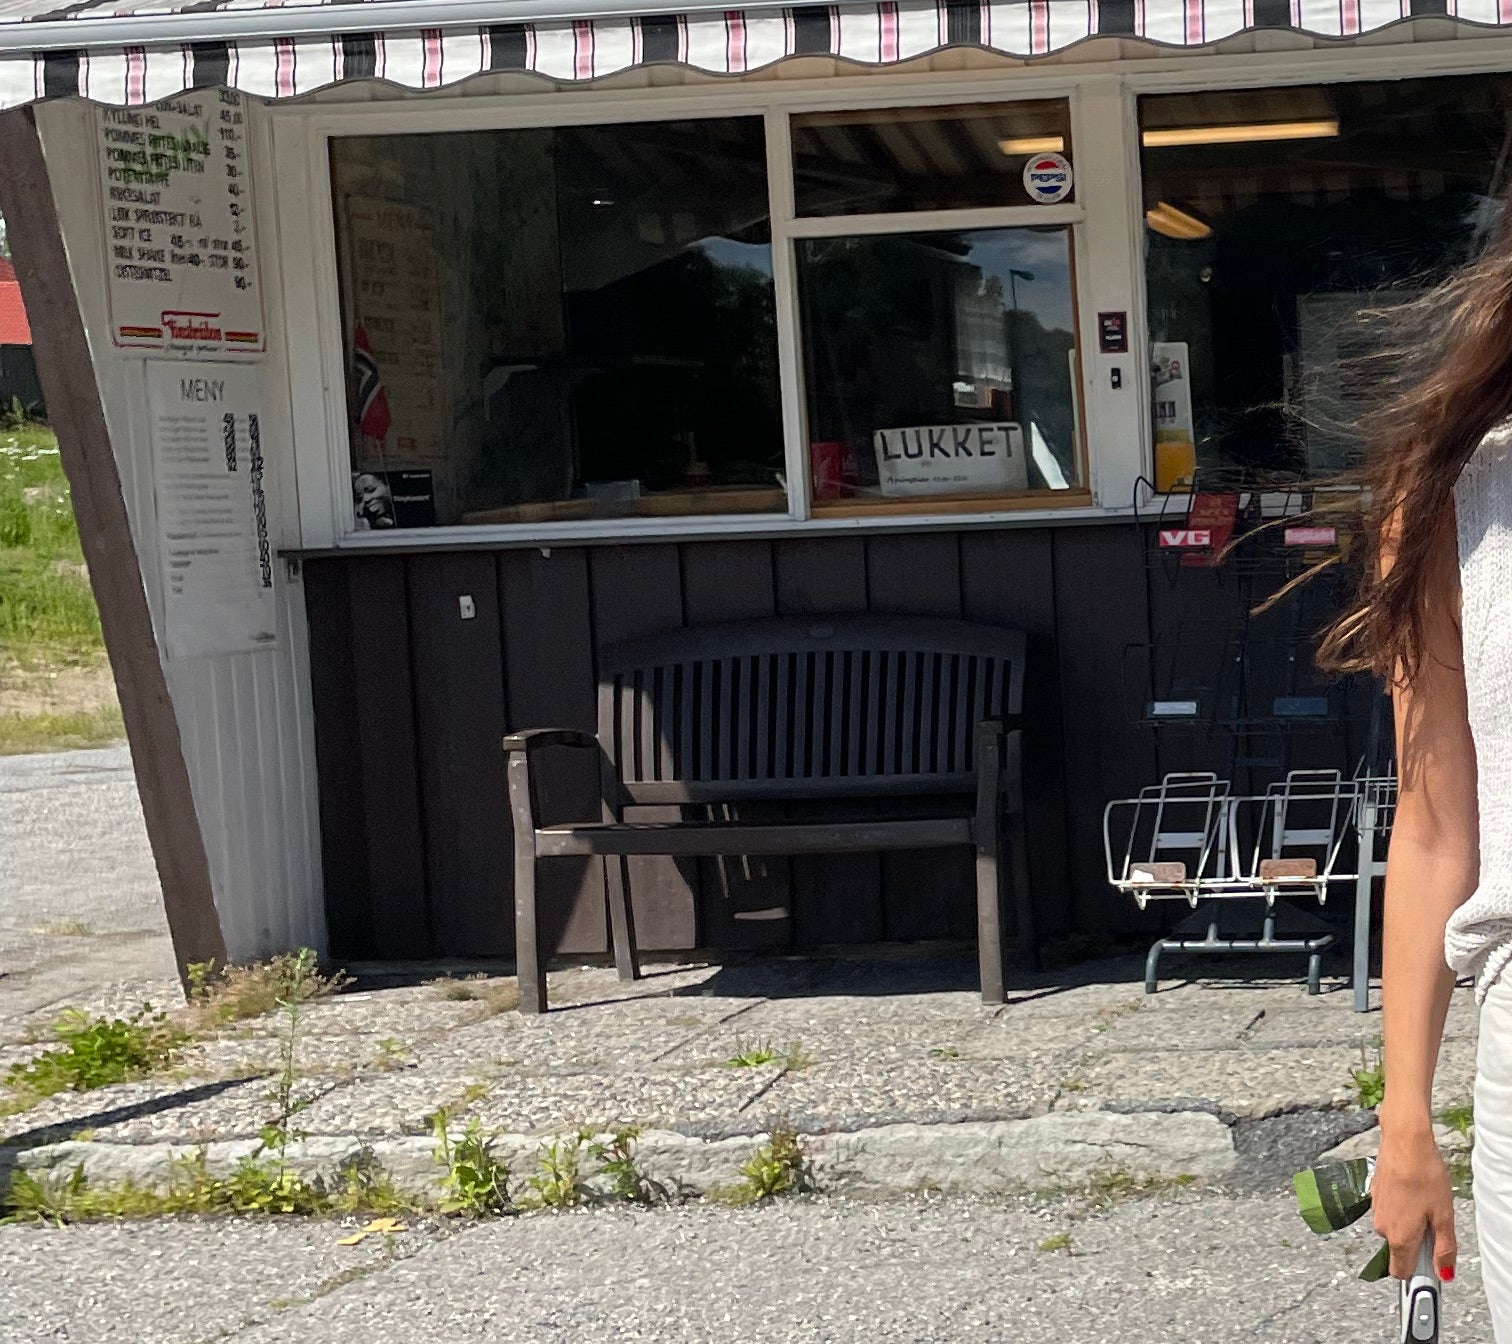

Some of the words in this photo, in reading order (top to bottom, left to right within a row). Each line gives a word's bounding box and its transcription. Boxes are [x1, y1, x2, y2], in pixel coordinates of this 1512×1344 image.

[180, 379, 225, 402] MENY
[880, 426, 1018, 461] LUKKET
[1161, 530, 1211, 546] VG
